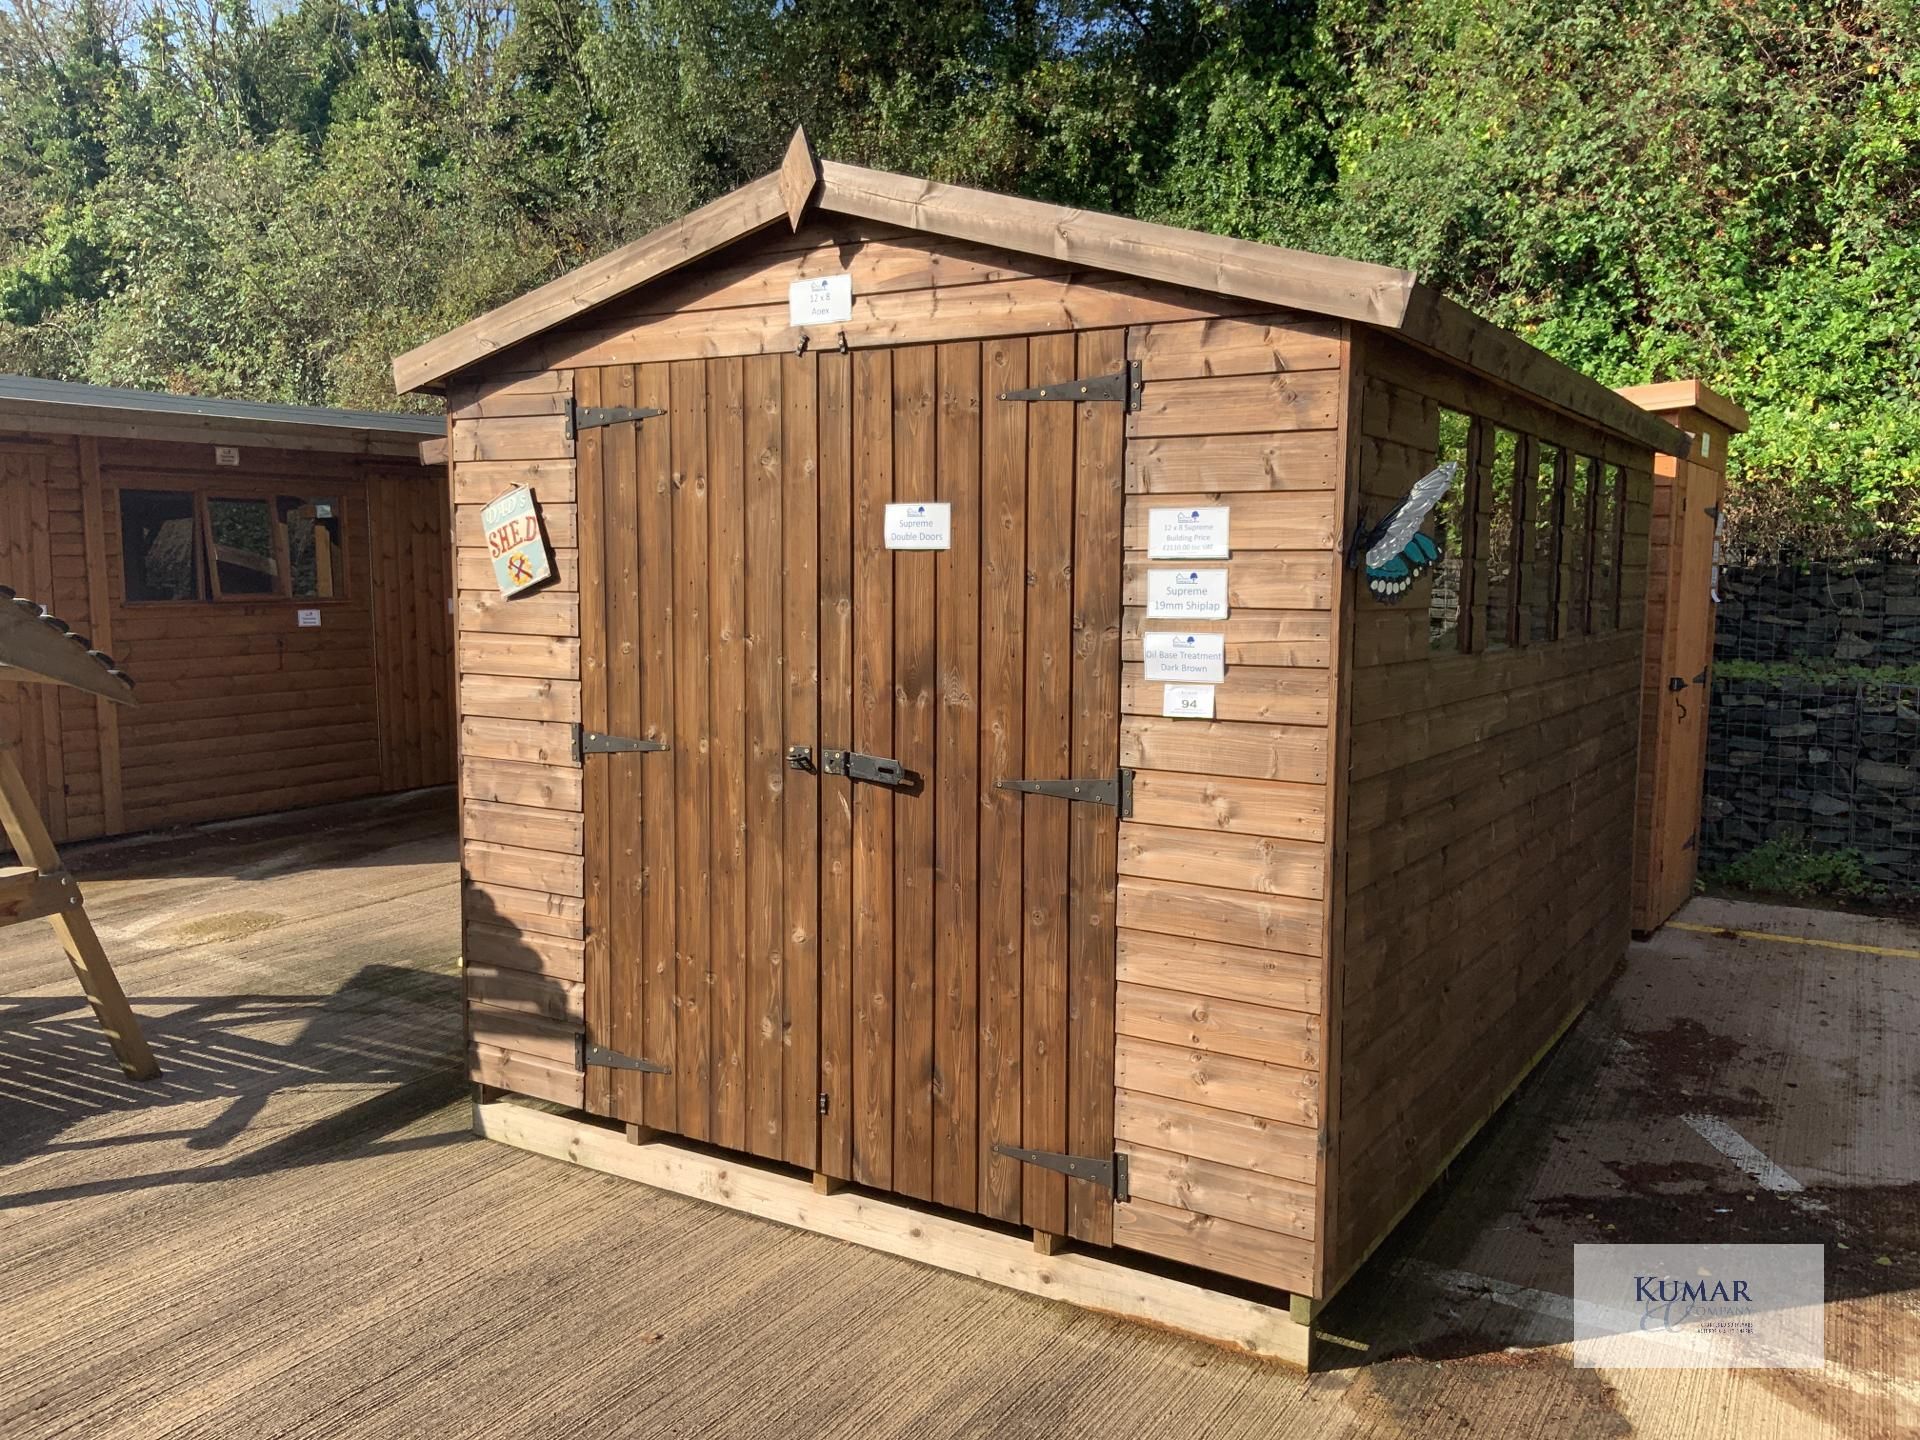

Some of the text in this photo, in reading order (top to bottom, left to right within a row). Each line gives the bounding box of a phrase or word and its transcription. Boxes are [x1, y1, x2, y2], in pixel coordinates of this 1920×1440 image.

[810, 294, 818, 303] 12
[811, 307, 830, 316] Apex
[899, 520, 934, 529] Supreme
[488, 515, 538, 559] SHED
[891, 532, 943, 541] Double Doors
[1166, 533, 1211, 543] Building Price
[1166, 586, 1208, 597] Supreme
[1155, 600, 1220, 612] 19mm Shiplap
[1146, 650, 1222, 661] Oil Base Treatment
[1160, 663, 1208, 673] Dark Brown
[1181, 699, 1197, 709] 94
